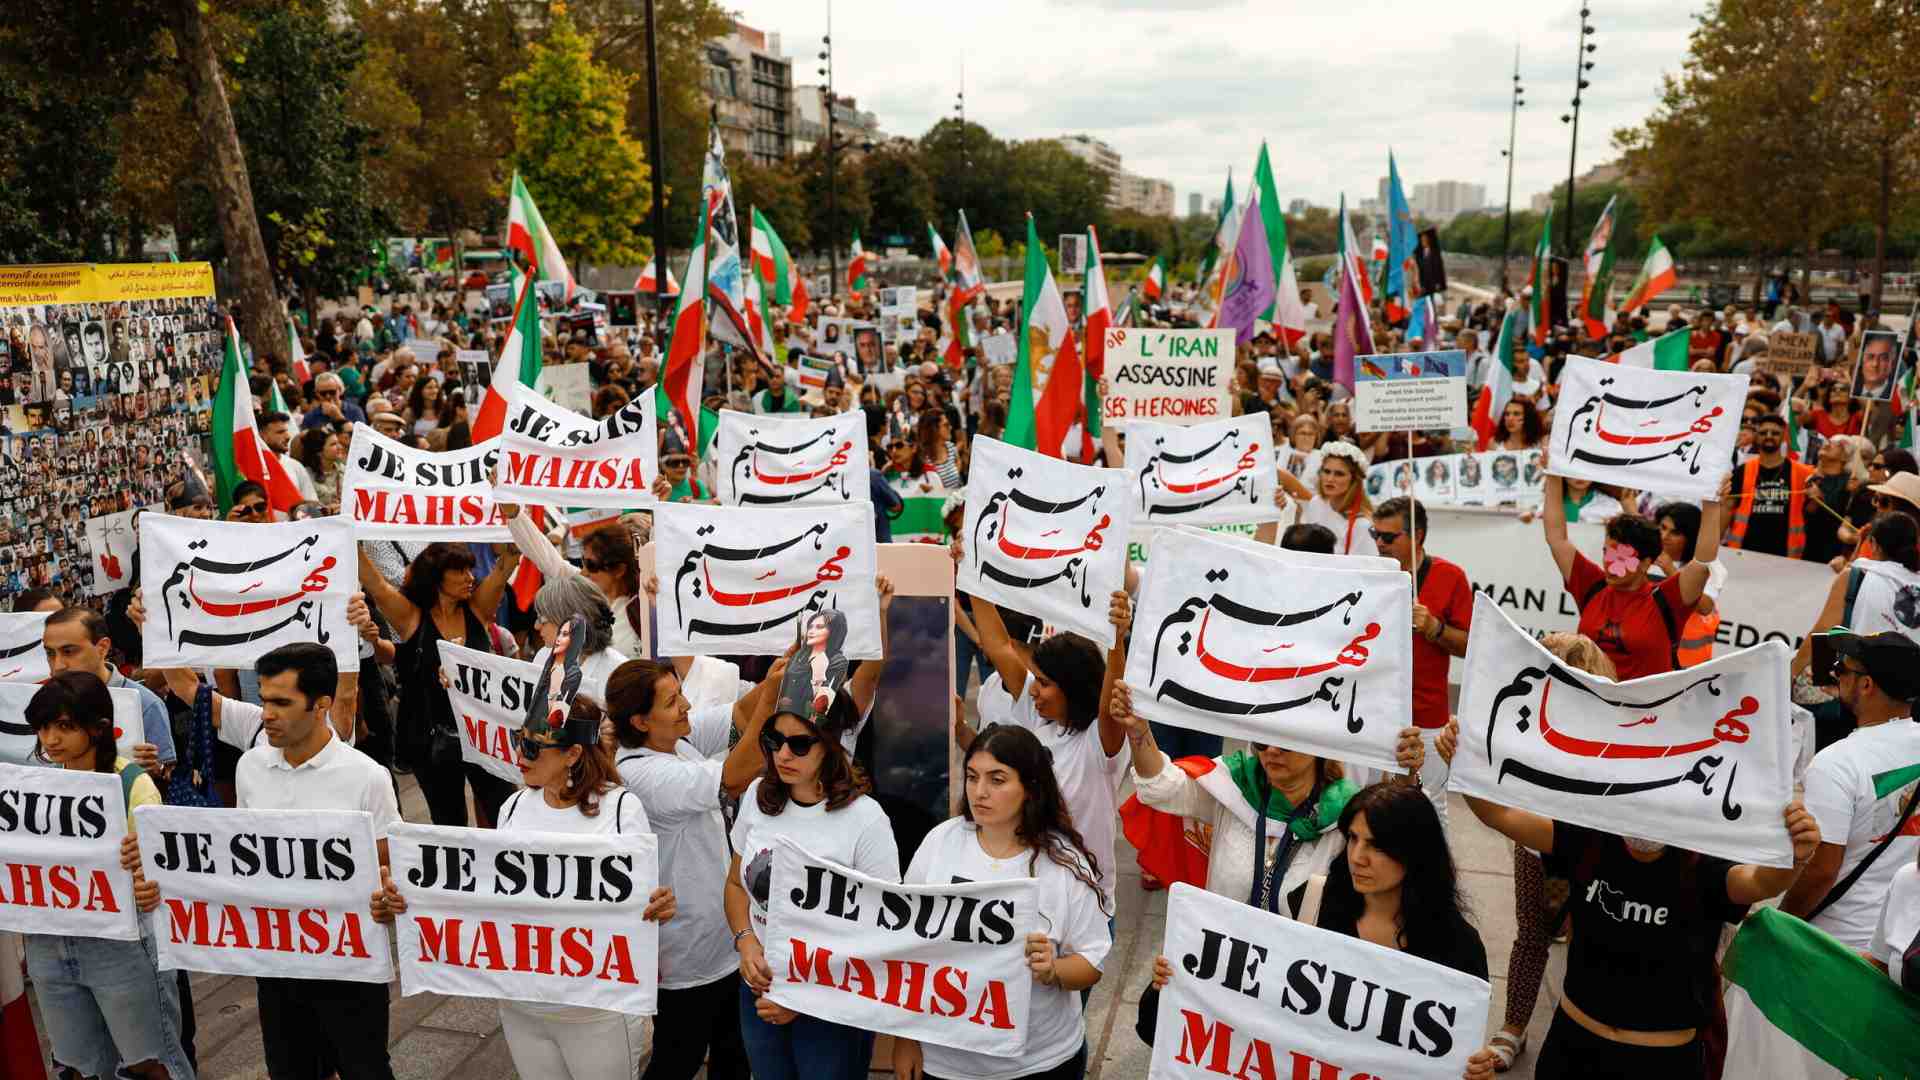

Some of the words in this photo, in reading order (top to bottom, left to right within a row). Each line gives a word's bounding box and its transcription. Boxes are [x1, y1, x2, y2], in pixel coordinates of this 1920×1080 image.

[1115, 363, 1218, 387] ASSASSINE
[511, 404, 560, 442] JE
[1104, 396, 1127, 418] SES
[1566, 378, 1708, 455] هستیم
[358, 443, 404, 482] JE
[503, 451, 647, 490] MAHSA
[353, 488, 511, 526] MAHSA
[974, 466, 1107, 569] هستیم
[162, 533, 320, 641] هستیم
[675, 522, 828, 631] هستیم
[1472, 581, 1546, 612] MAN
[1150, 567, 1364, 689] هستیم
[454, 663, 491, 705] JE
[500, 674, 535, 713] SU
[463, 713, 519, 768] MA
[0, 789, 107, 840] SUIS
[154, 831, 218, 874] JE
[229, 833, 356, 883] SUIS
[406, 843, 478, 894] JE
[494, 848, 634, 903] SUIS
[0, 863, 121, 913] HSA
[789, 864, 865, 922] JE
[875, 888, 1016, 947] SUIS
[164, 897, 373, 960] MAHSA
[414, 915, 641, 985] MAHSA
[785, 936, 1017, 1031] MAHSA
[1182, 928, 1268, 999] JE
[1280, 959, 1457, 1059] SUIS
